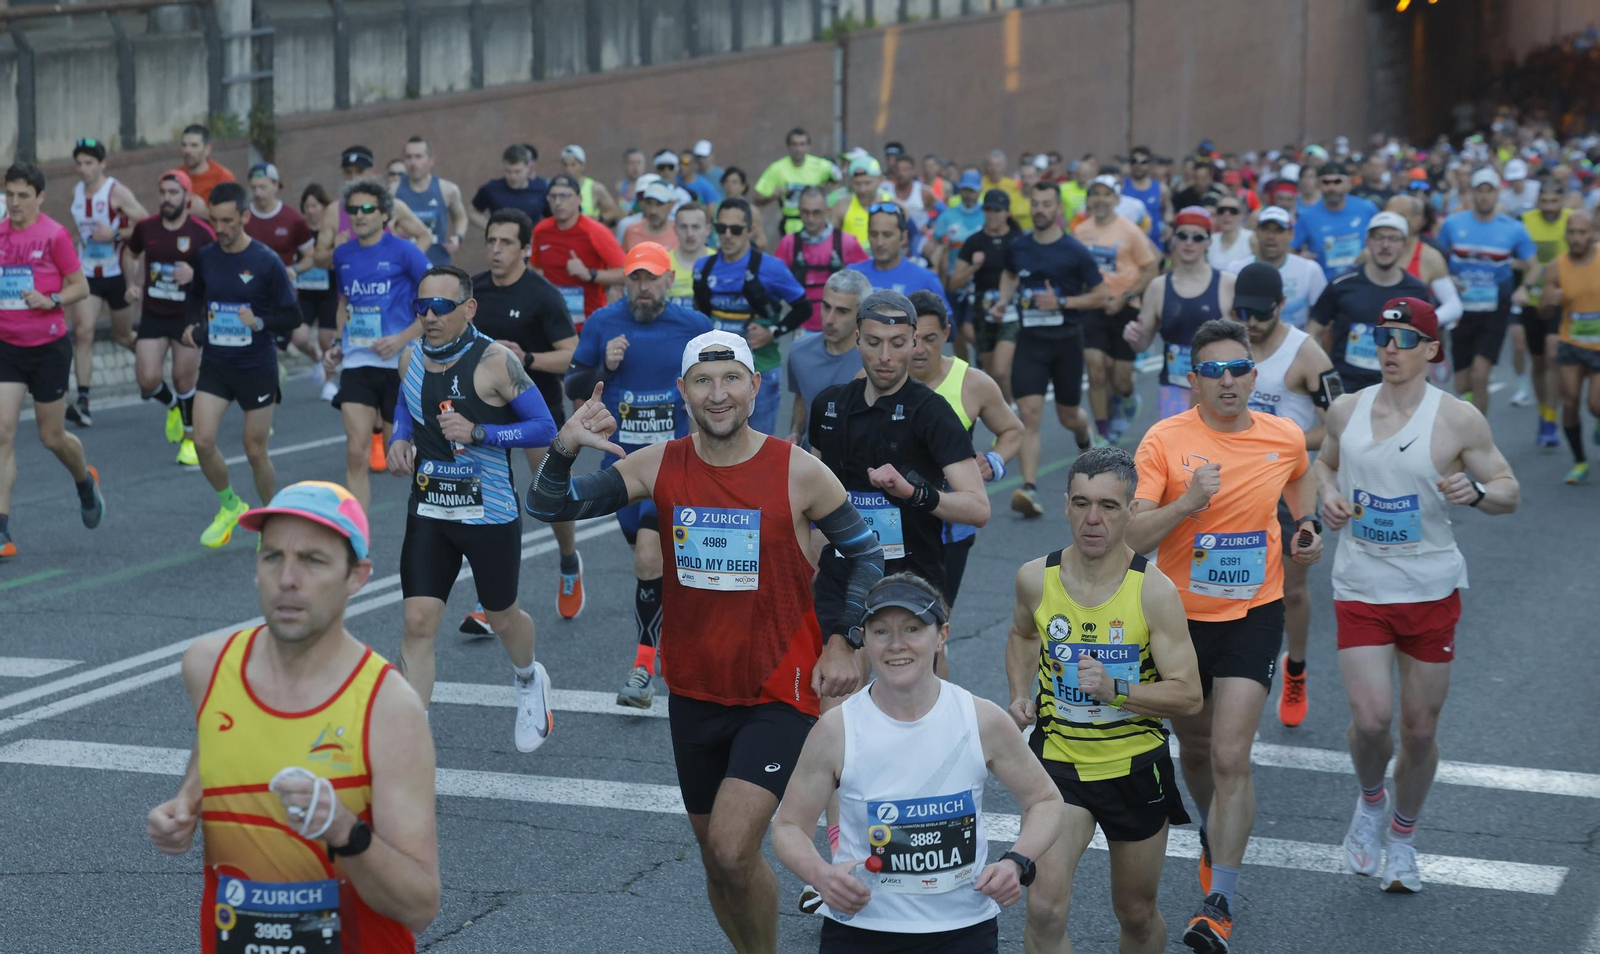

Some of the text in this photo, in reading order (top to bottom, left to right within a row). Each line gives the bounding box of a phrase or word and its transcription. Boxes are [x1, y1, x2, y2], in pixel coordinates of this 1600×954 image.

[637, 393, 669, 403] ZURICH
[637, 409, 656, 418] 3716
[437, 465, 473, 475] ZURICH
[439, 482, 456, 492] 3751
[425, 491, 475, 506] JUANMA
[1373, 499, 1411, 510] ZURICH
[702, 513, 749, 525] ZURICH
[1362, 525, 1408, 542] TOBIAS
[702, 537, 727, 548] 4989
[1220, 536, 1260, 547] ZURICH
[677, 555, 758, 572] HOLD MY BEER
[1220, 557, 1241, 566] 6391
[1208, 569, 1250, 583] DAVID
[905, 799, 964, 818] ZURICH
[910, 831, 942, 847] 3882
[890, 847, 962, 872] NICOLA
[251, 888, 322, 905] ZURICH
[254, 922, 293, 940] 3905
